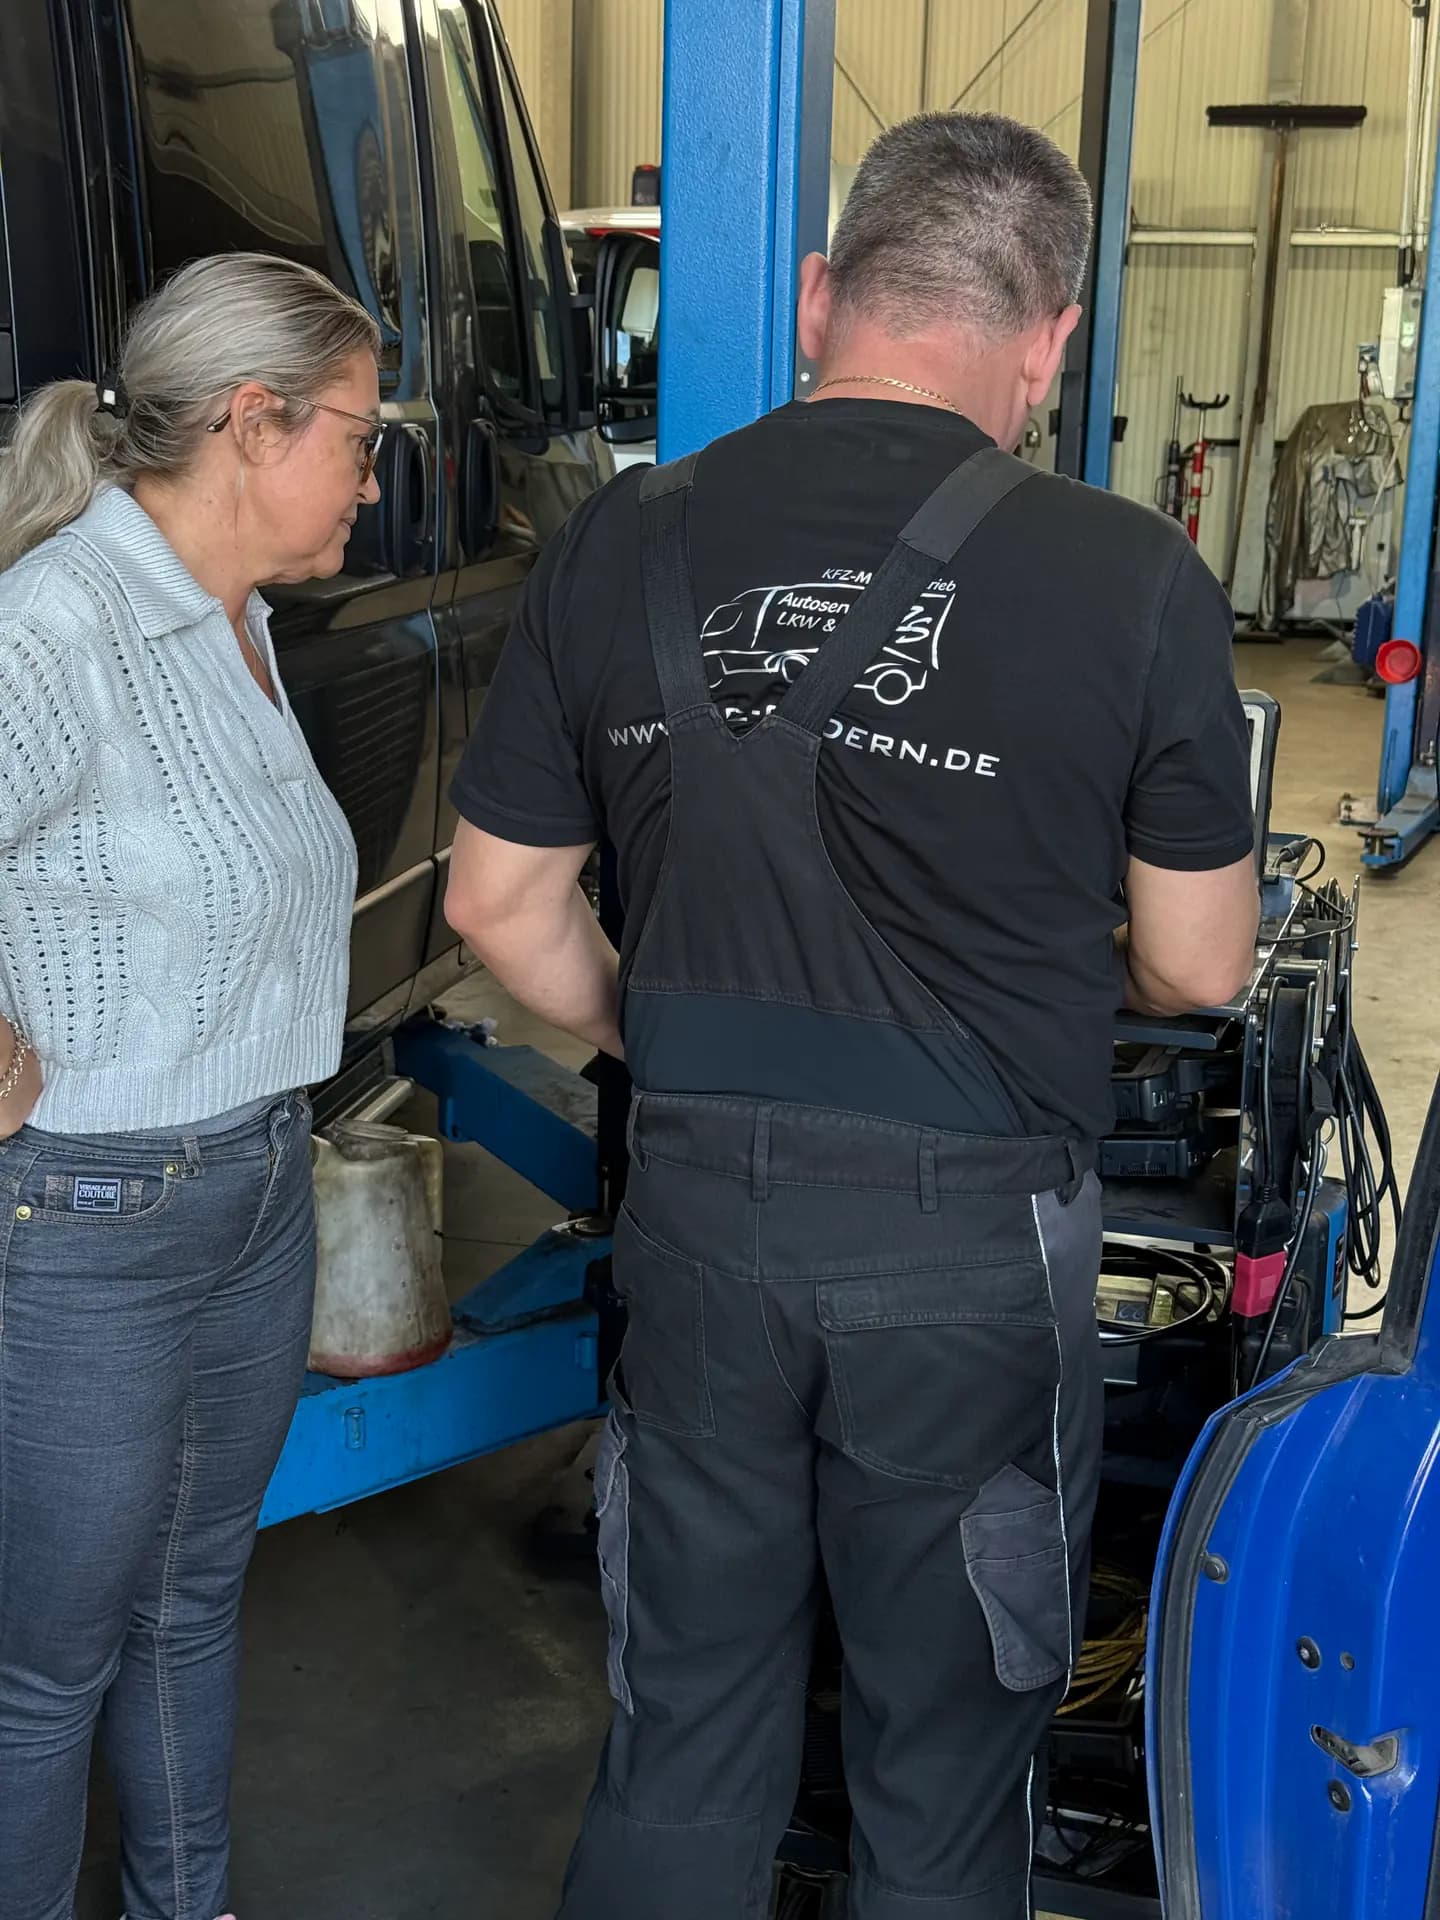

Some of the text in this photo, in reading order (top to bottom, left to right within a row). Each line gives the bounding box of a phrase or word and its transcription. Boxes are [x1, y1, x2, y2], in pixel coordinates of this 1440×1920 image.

[776, 611, 837, 632] LKW &
[78, 1190, 117, 1199] COUTURE
